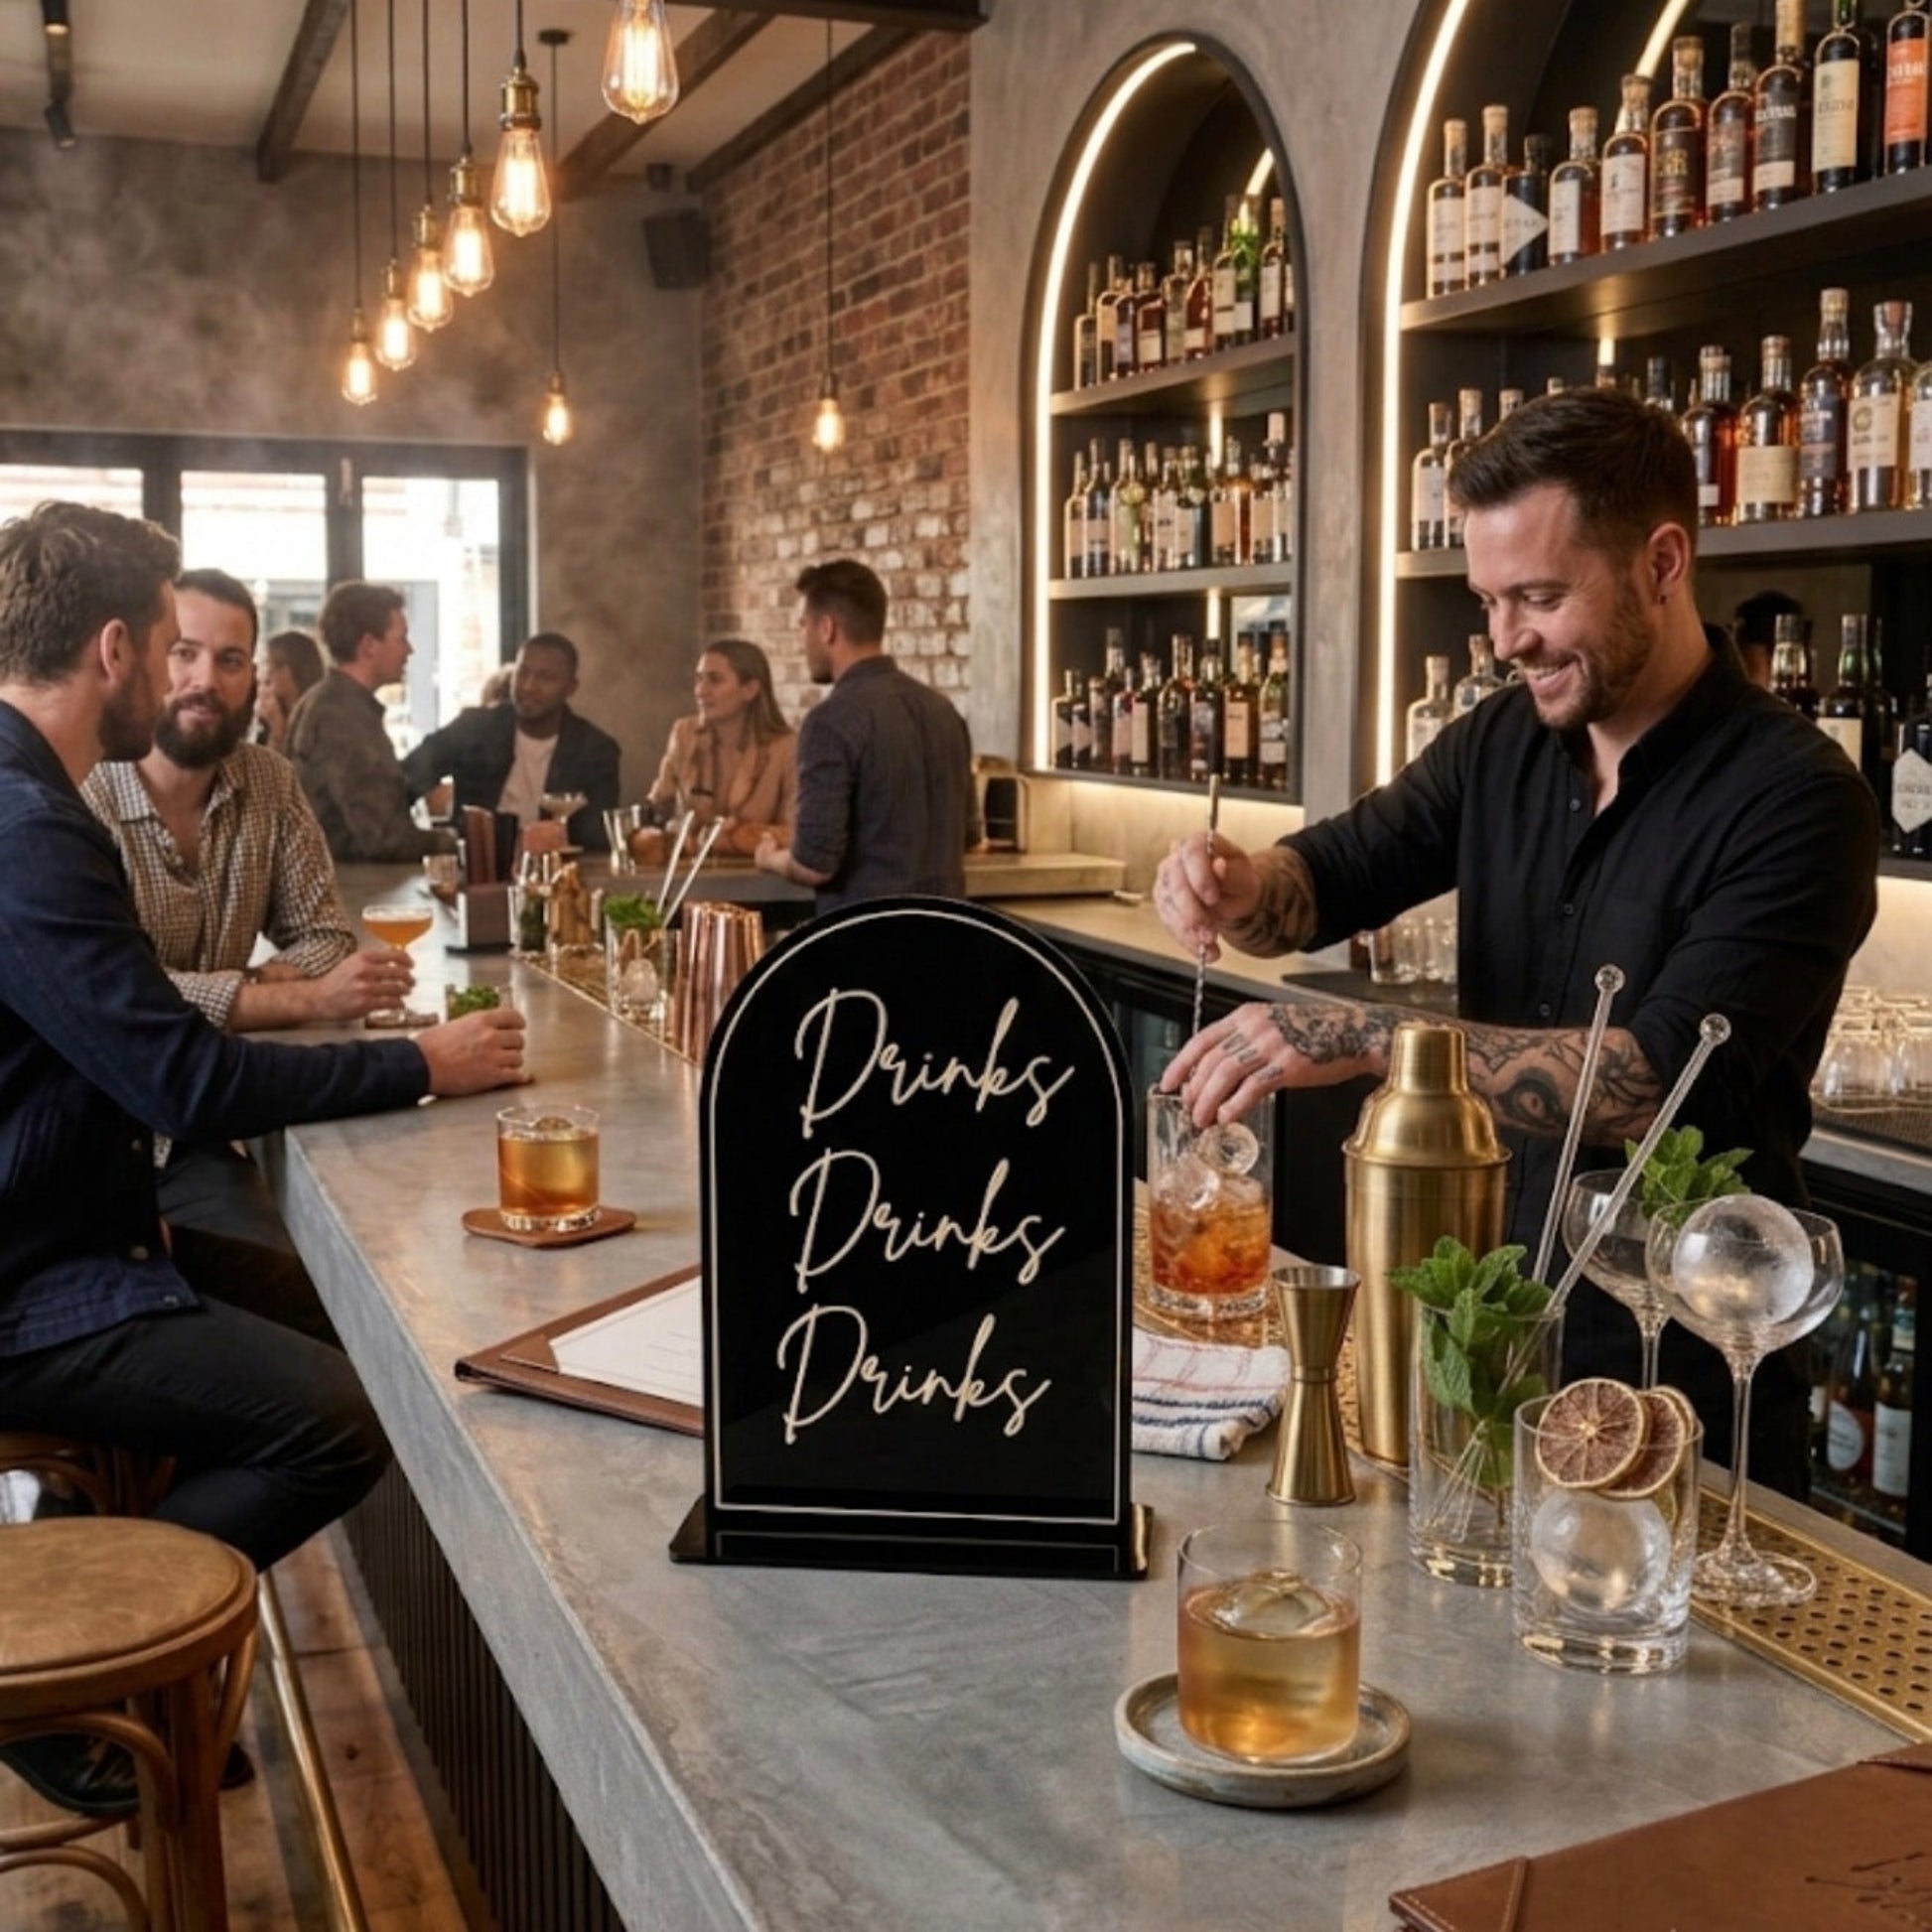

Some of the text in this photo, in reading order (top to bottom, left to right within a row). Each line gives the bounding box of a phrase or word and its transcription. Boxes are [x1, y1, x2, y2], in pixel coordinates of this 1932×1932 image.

[795, 989, 1075, 1138] Drinks
[789, 1148, 1065, 1294] Drinks
[777, 1304, 1051, 1445] Drinks
